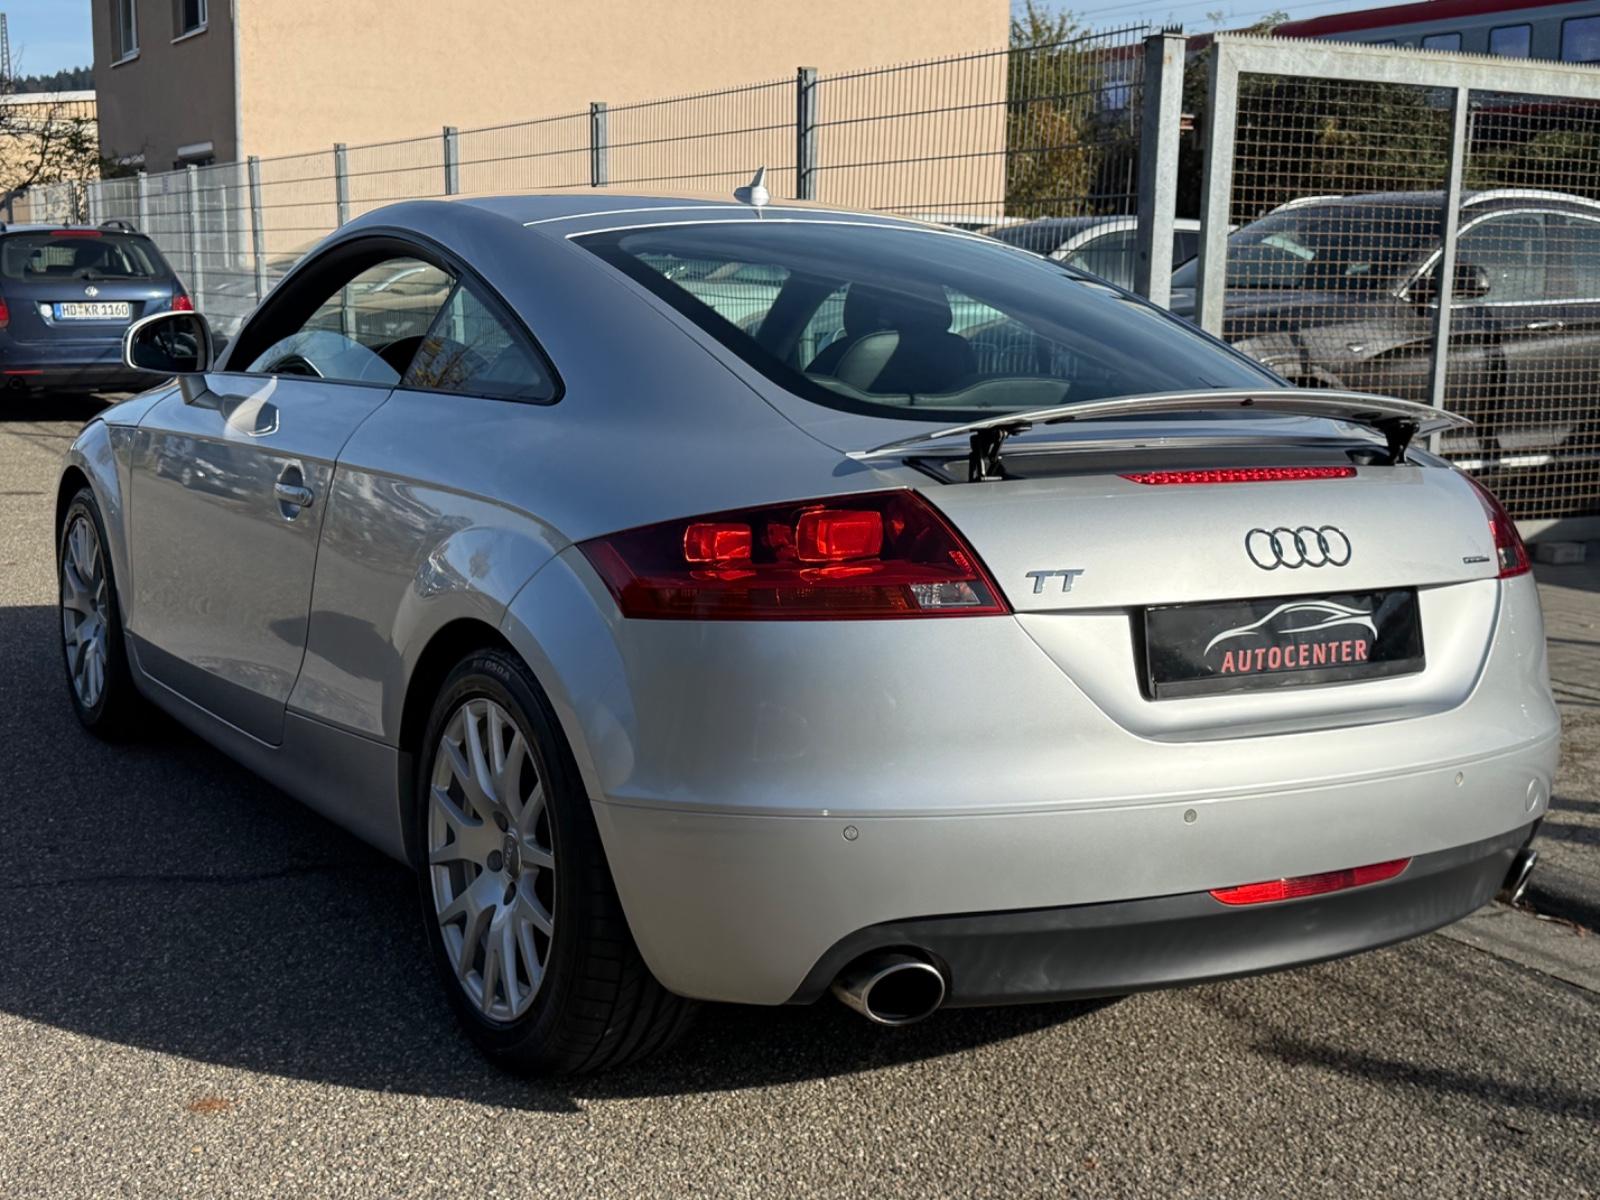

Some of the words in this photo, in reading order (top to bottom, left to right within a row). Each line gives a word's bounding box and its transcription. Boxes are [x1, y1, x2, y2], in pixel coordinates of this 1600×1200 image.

[101, 304, 128, 315] 1160
[1025, 569, 1084, 593] TT
[1221, 639, 1367, 673] AUTOCENTER
